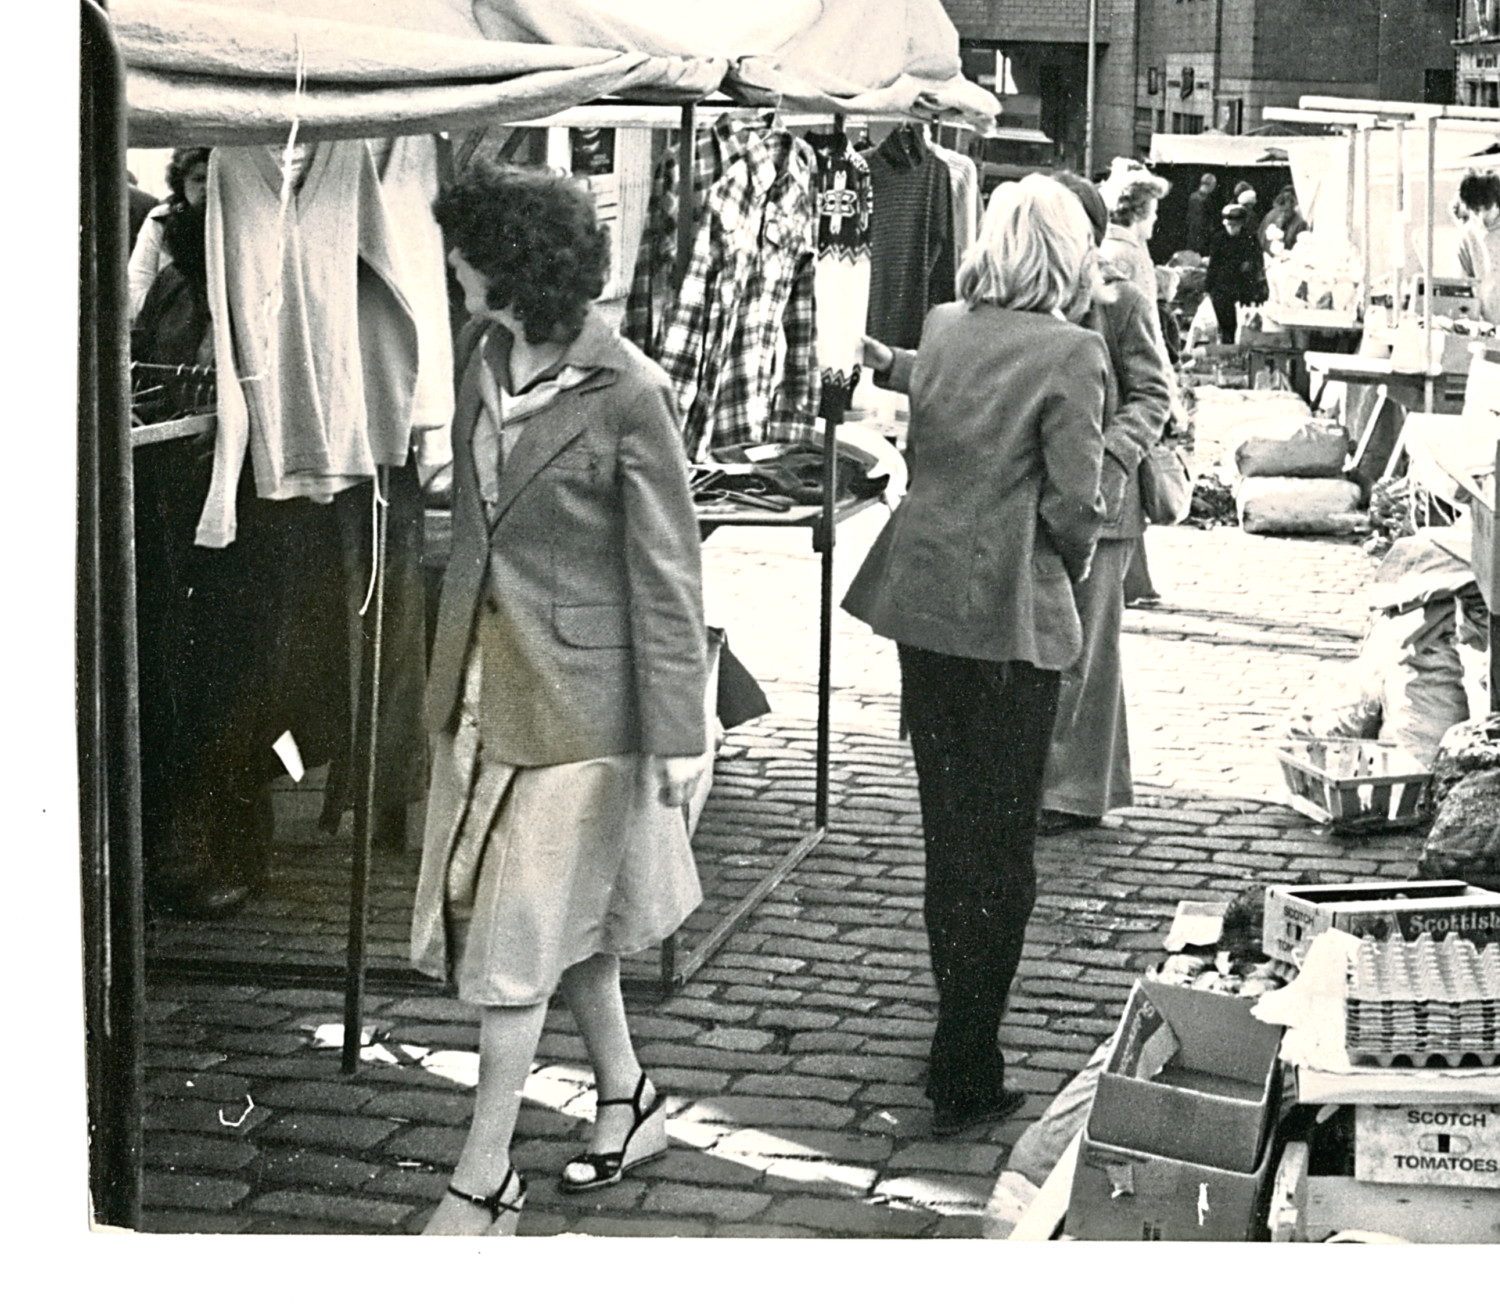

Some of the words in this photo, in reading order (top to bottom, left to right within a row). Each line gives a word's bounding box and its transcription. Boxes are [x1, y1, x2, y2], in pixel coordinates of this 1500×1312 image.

[1283, 904, 1315, 928] SCOTCH
[1406, 1109, 1487, 1128] SCOTCH
[1392, 1153, 1499, 1173] TOMATOES
